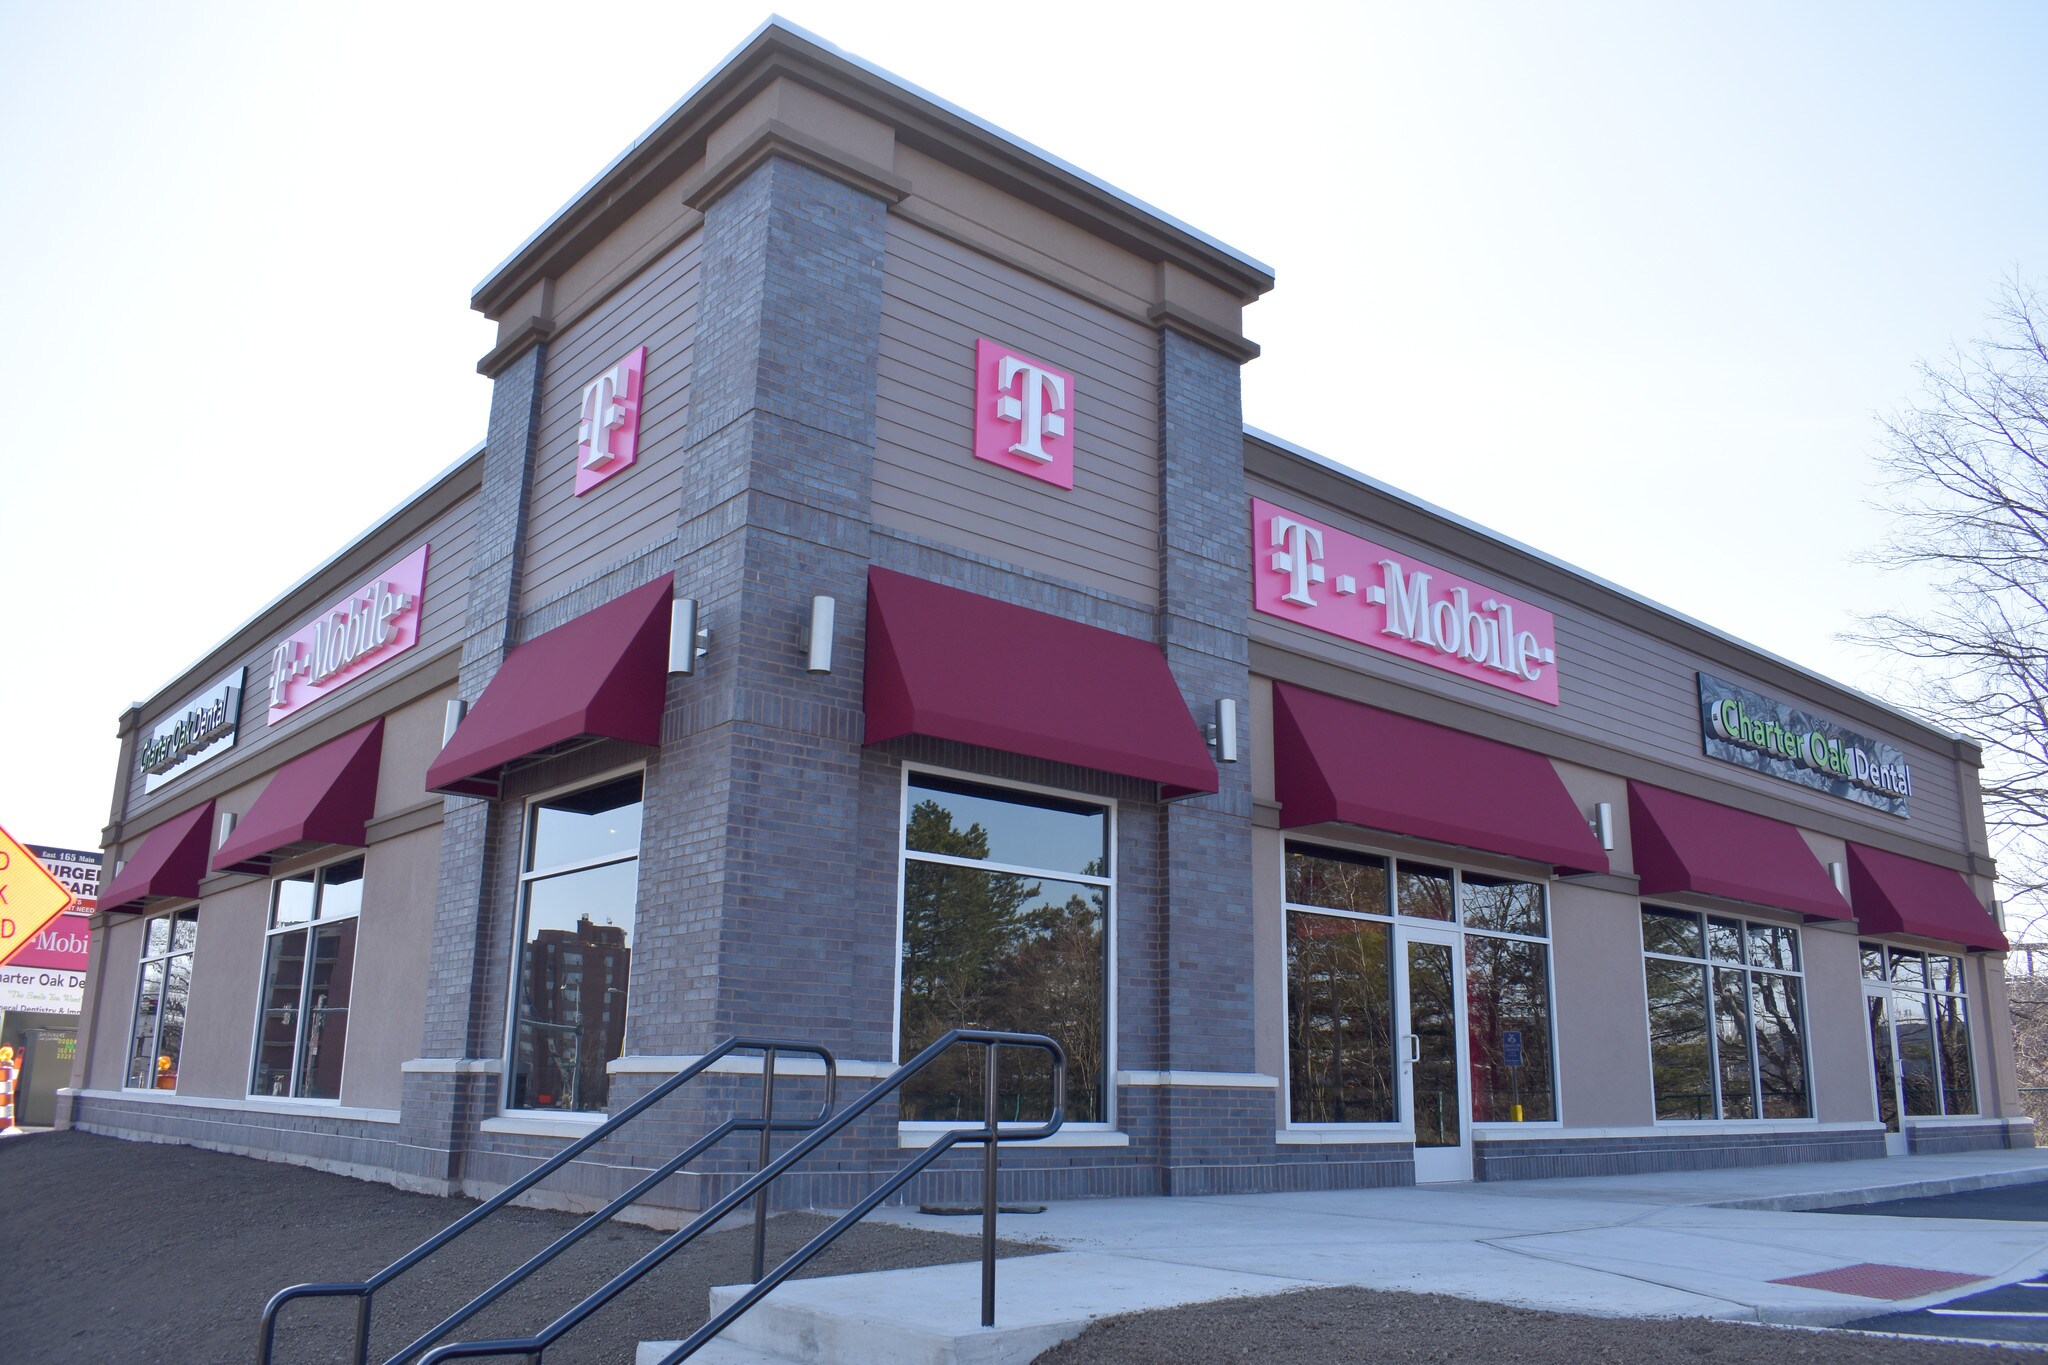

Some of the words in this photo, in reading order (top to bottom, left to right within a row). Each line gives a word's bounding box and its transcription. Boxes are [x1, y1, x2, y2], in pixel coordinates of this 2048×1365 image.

[140, 737, 173, 773] Charter
[172, 711, 194, 753] Oak
[192, 686, 232, 741] Dental
[1717, 699, 1804, 758] Charter
[1808, 731, 1852, 777] Oak
[1853, 747, 1912, 797] Dental
[42, 851, 57, 859] East
[60, 853, 77, 862] 165
[48, 864, 101, 882] URGE
[39, 974, 64, 987] Oak
[69, 976, 86, 989] De
